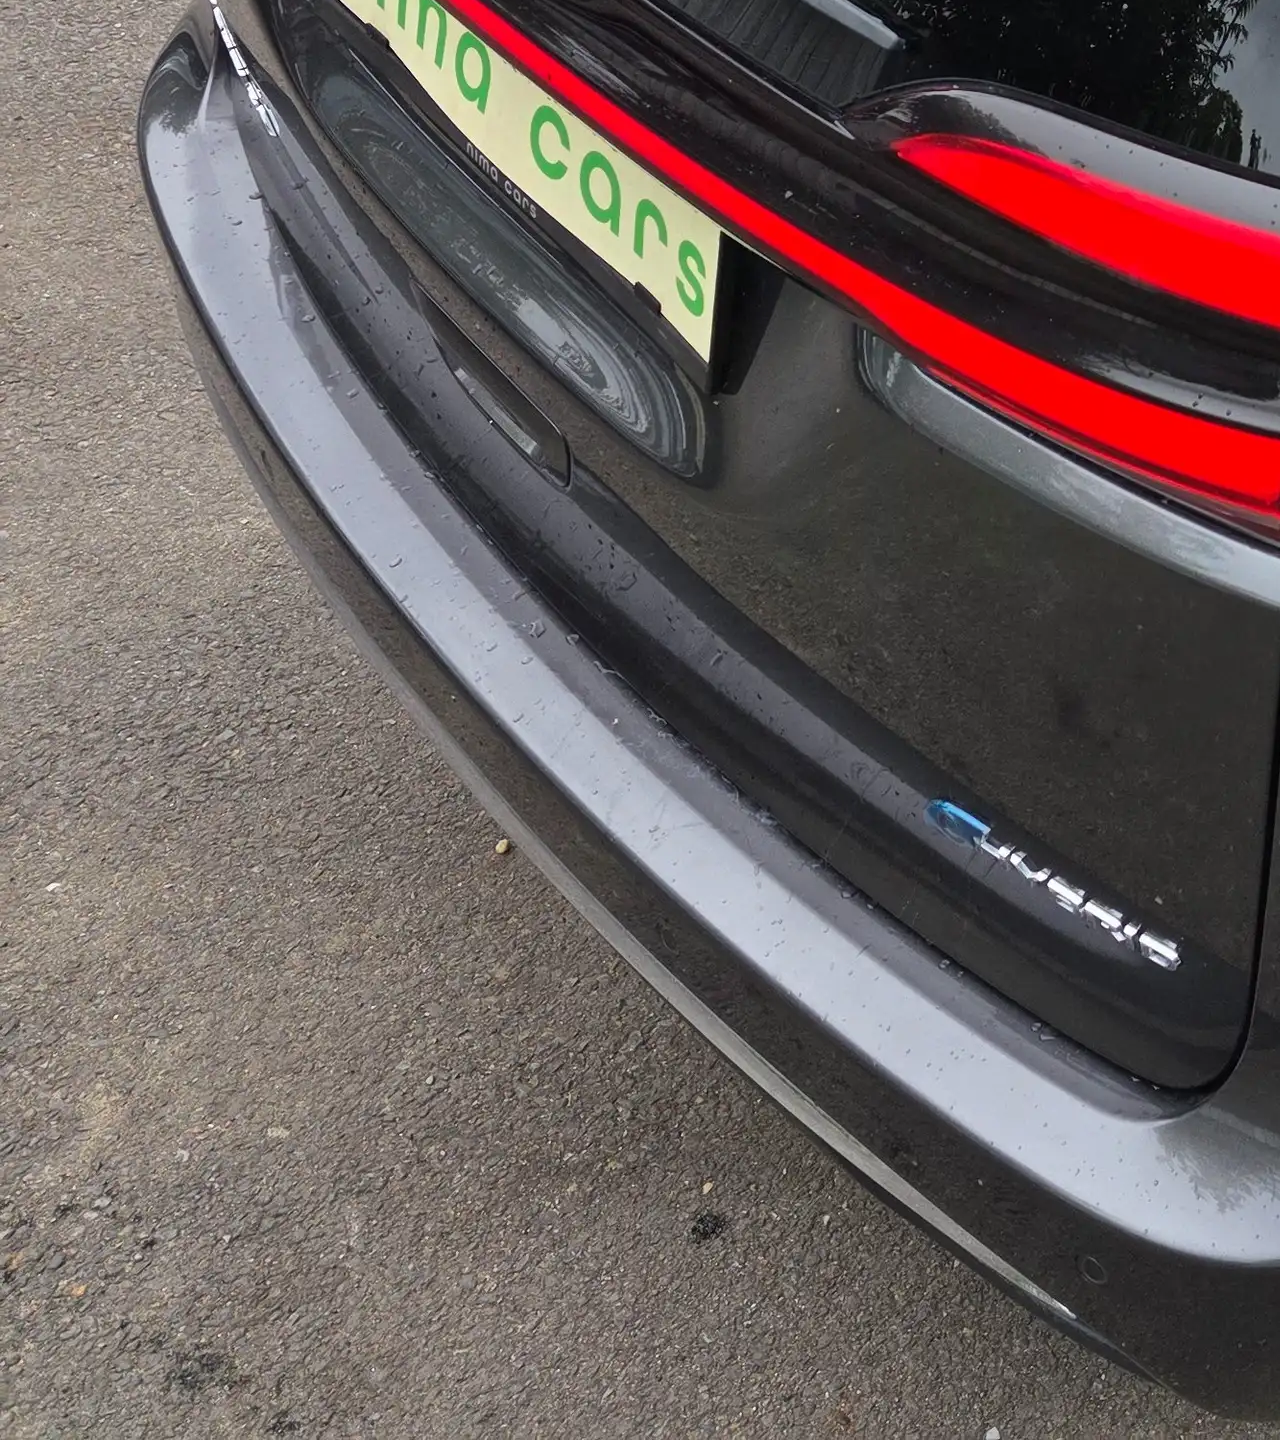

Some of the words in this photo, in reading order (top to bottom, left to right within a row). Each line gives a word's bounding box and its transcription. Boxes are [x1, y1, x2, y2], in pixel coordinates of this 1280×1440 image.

[466, 141, 499, 182] nima
[504, 180, 537, 219] cars
[530, 105, 706, 317] cars
